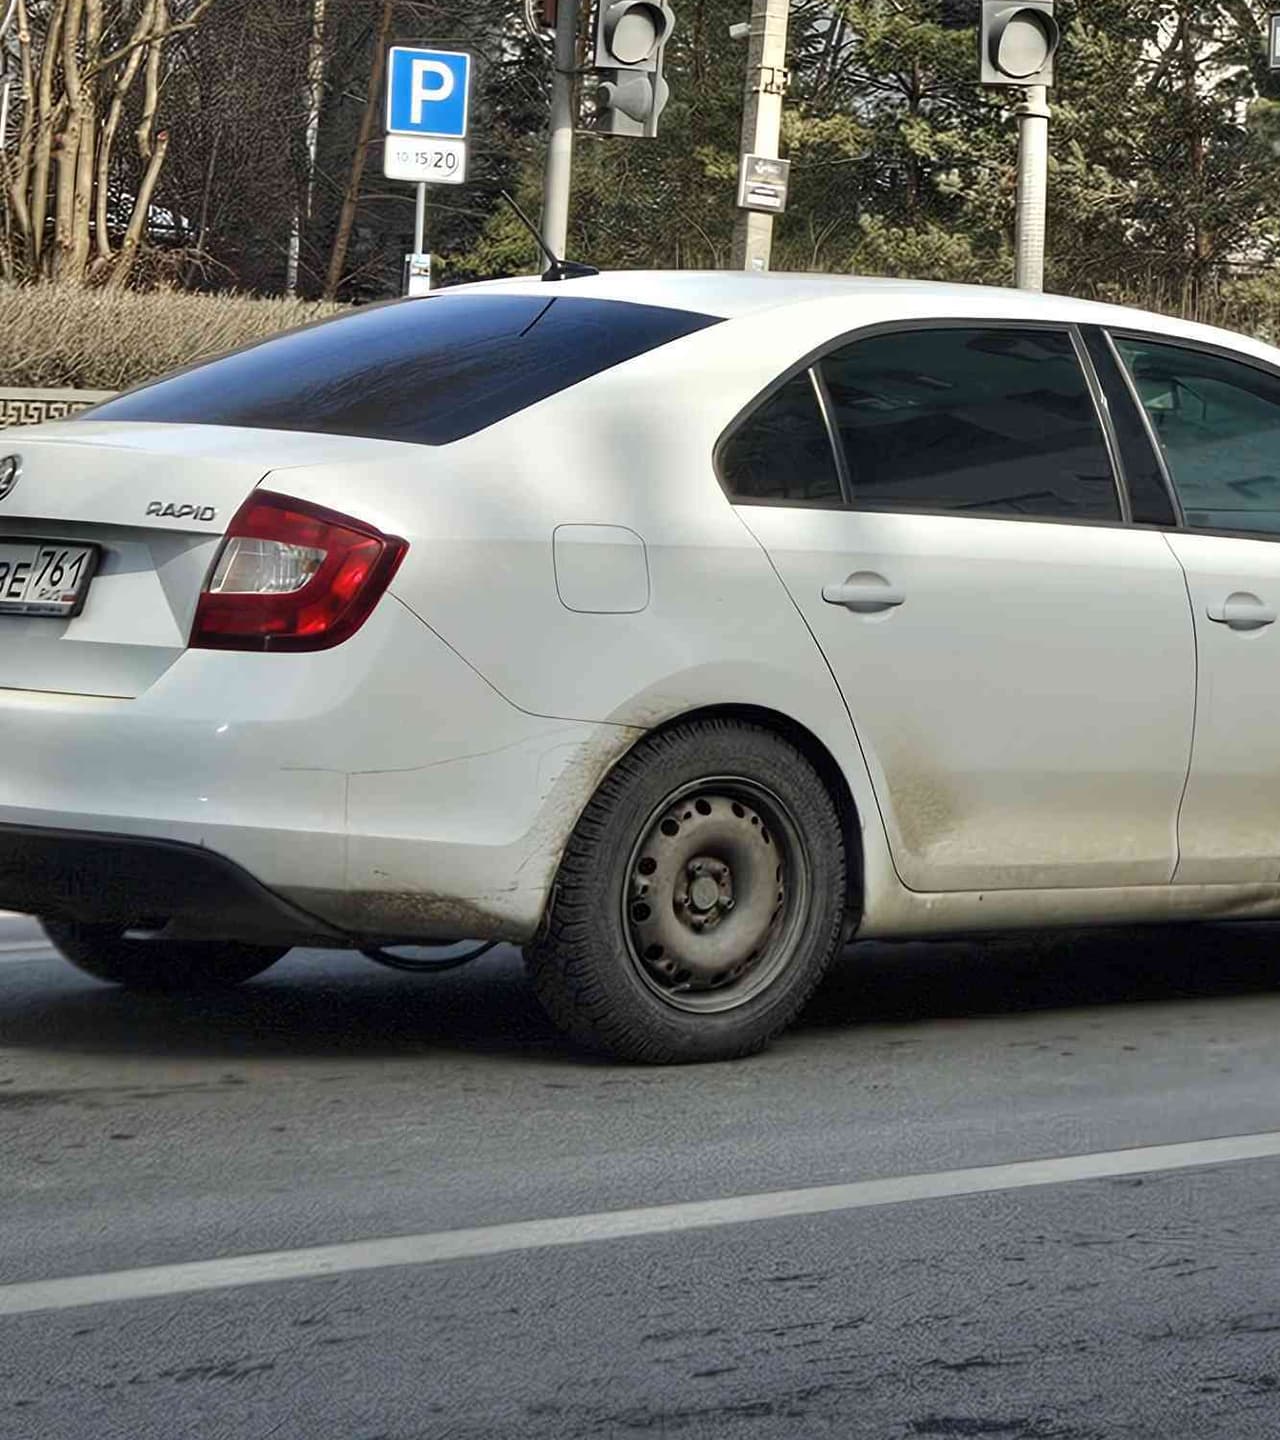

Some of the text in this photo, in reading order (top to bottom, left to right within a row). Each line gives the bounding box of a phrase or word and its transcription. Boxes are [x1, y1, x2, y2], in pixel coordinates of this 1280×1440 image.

[410, 58, 454, 124] P
[433, 151, 456, 169] 20
[146, 501, 215, 521] RAPID
[34, 550, 87, 588] 761
